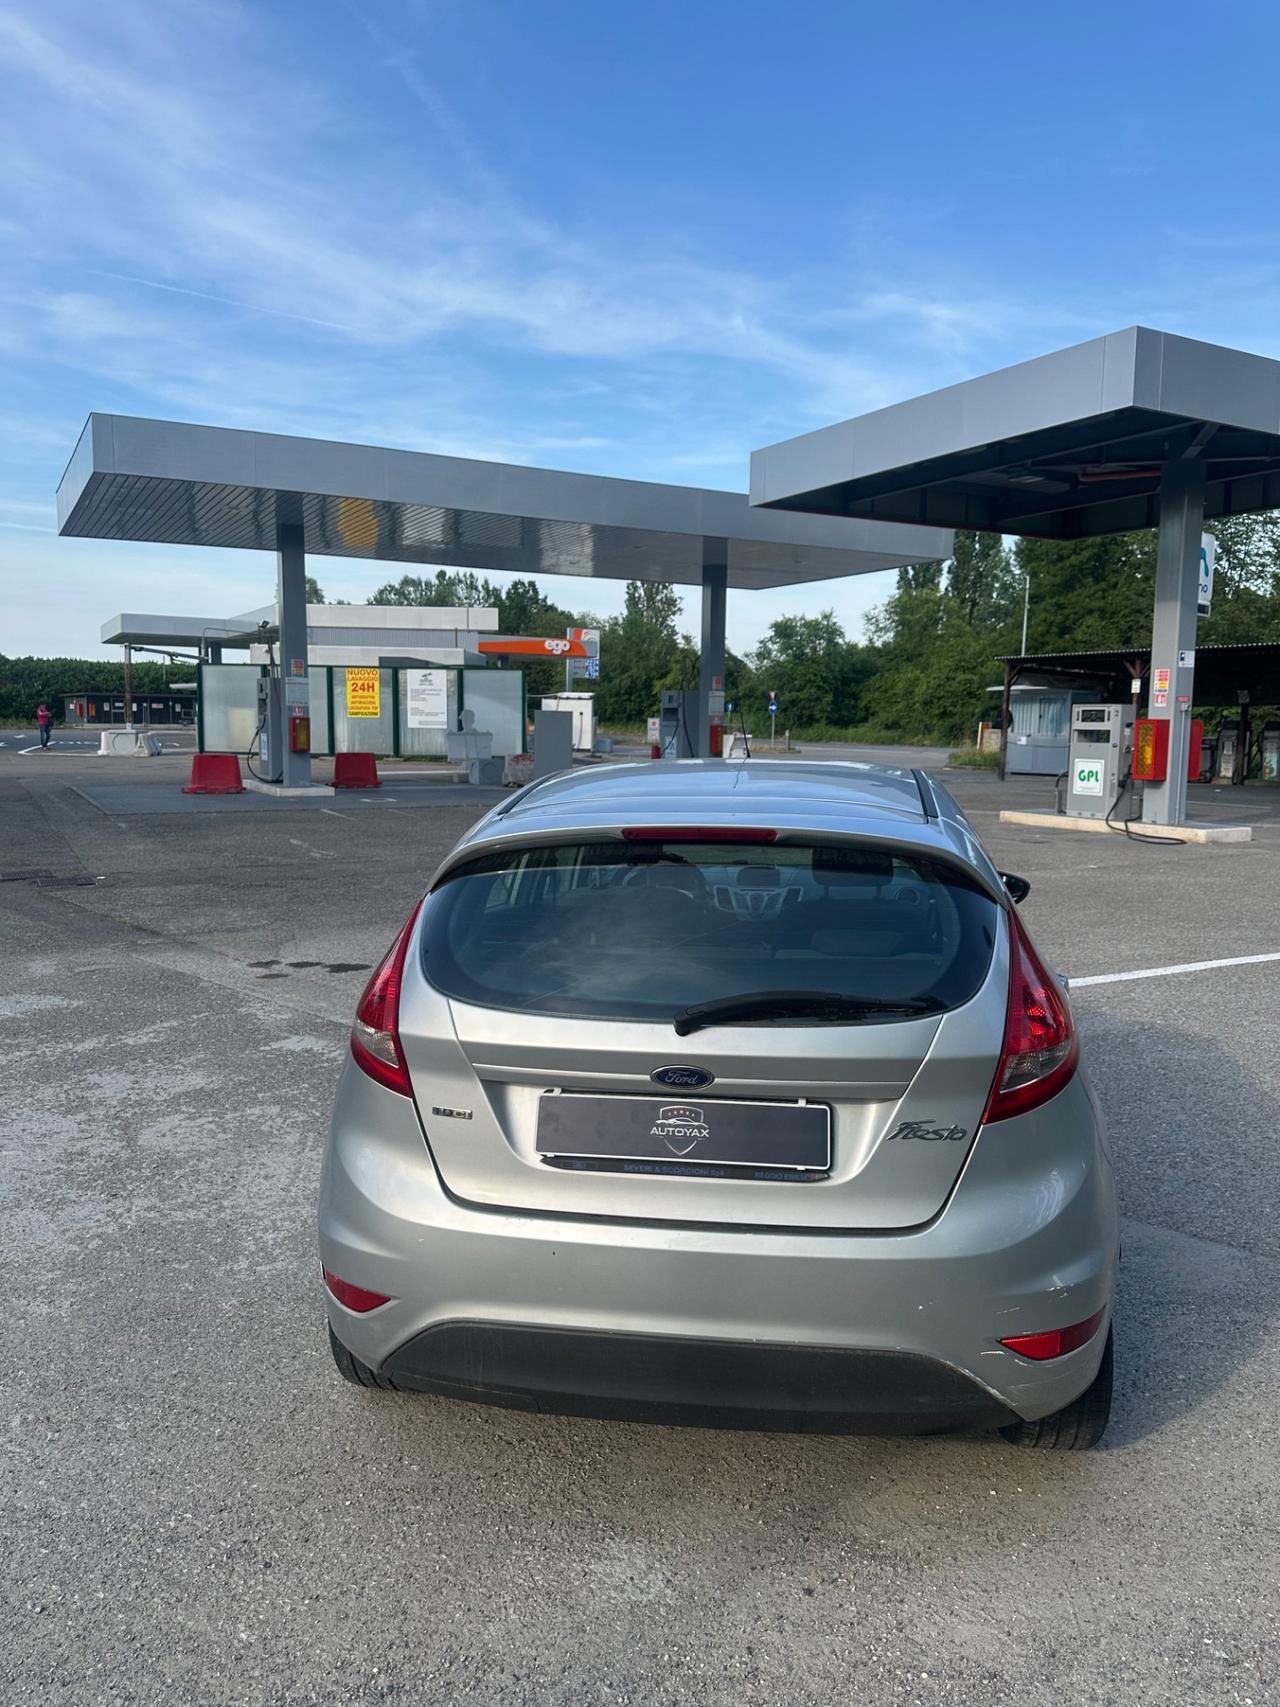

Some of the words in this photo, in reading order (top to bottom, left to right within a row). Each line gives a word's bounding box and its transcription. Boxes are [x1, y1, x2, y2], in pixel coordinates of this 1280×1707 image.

[544, 640, 570, 654] ego
[351, 682, 375, 692] 24H
[1078, 769, 1099, 782] GPL
[665, 1071, 699, 1085] Ford
[650, 1126, 710, 1138] AUTOYAX
[886, 1119, 968, 1141] Fiesta
